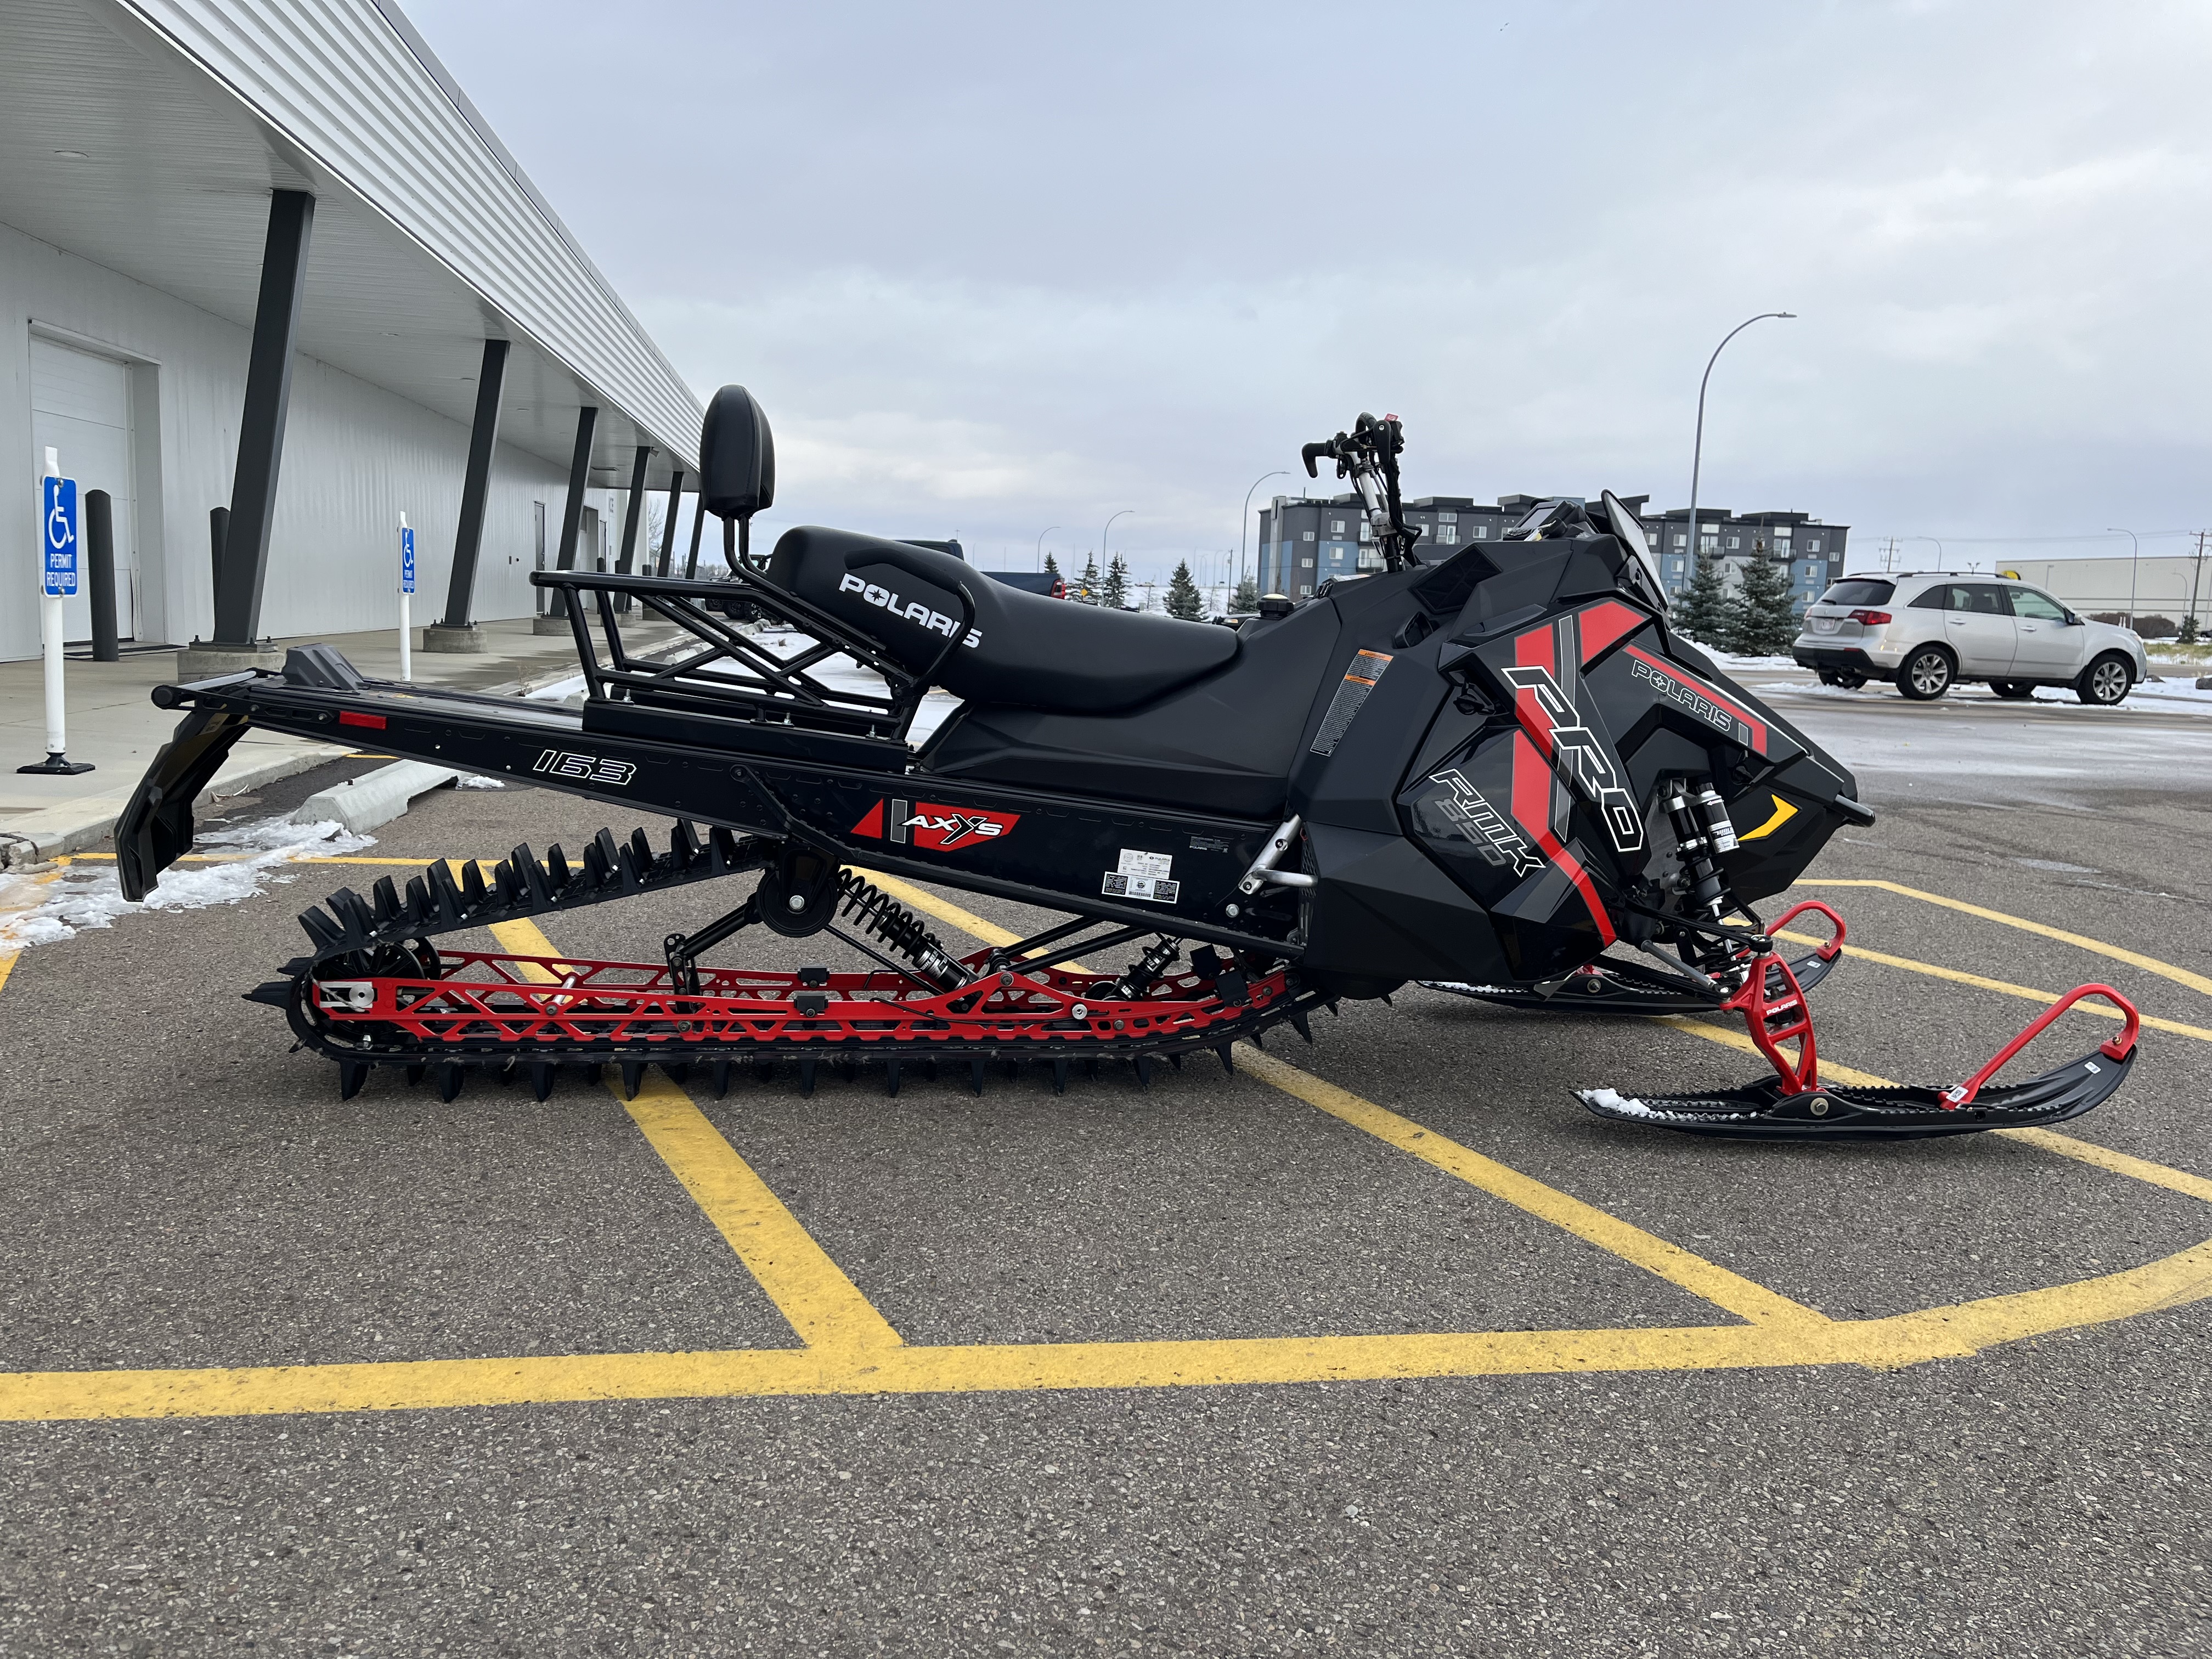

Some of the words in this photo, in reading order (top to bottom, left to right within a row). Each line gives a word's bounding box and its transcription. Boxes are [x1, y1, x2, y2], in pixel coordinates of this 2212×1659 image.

[47, 571, 76, 587] REQUIRED
[50, 553, 72, 568] PERMIT
[839, 573, 983, 648] POLARIS
[1632, 659, 1732, 732] POLARIS
[532, 749, 637, 785] 163
[1500, 665, 1644, 852] PRO
[900, 813, 1003, 845] AXYS
[1428, 768, 1546, 877] RMK
[1434, 798, 1507, 866] 850
[1766, 999, 1798, 1015] POLARIS
